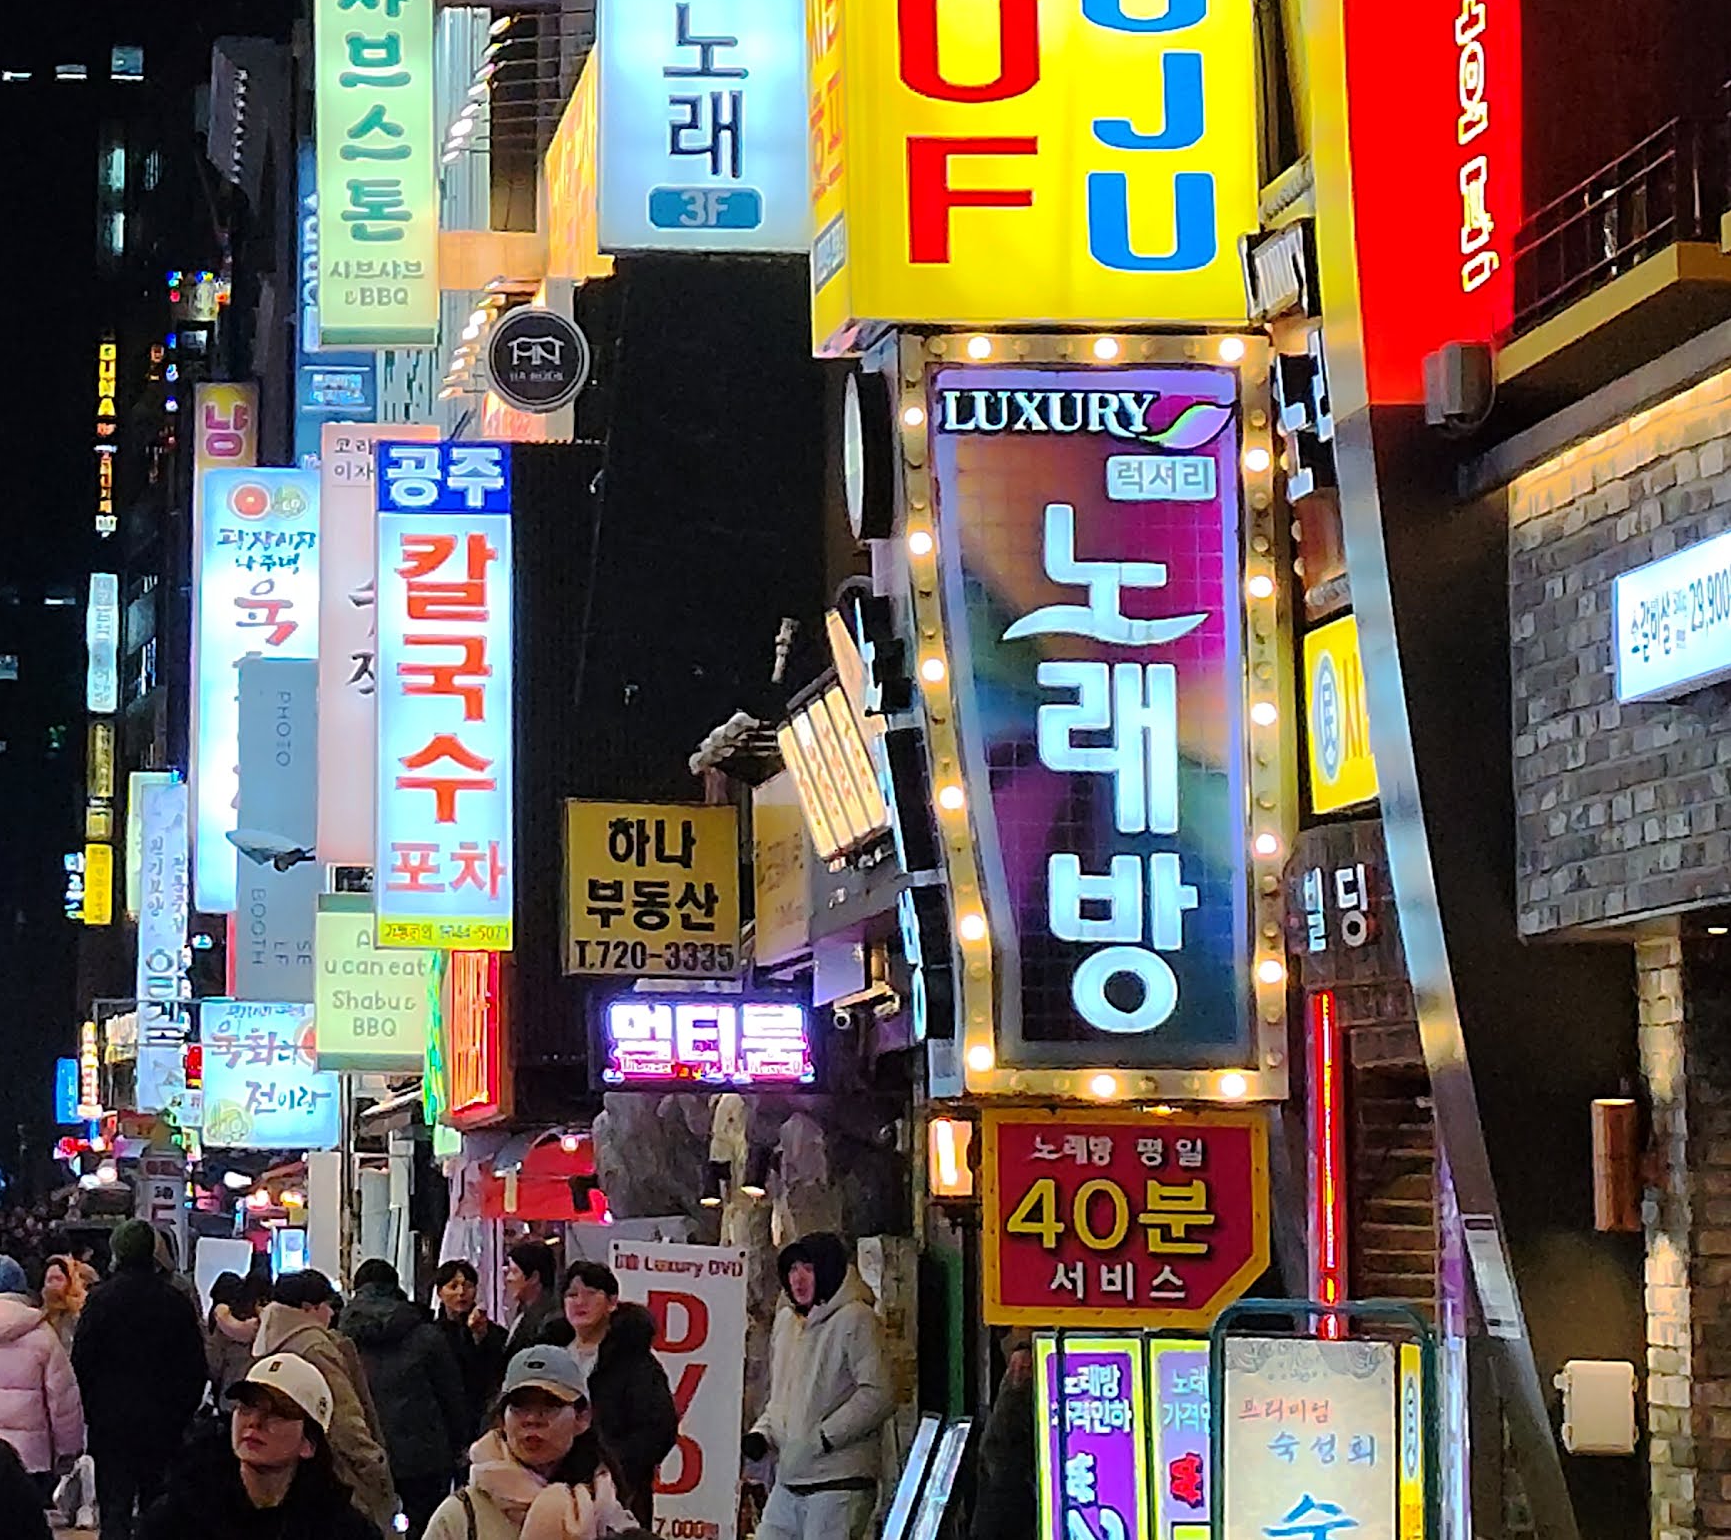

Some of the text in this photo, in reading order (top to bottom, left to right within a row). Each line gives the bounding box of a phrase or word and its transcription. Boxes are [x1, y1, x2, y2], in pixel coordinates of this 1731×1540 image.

[678, 193, 730, 227] 3F
[942, 391, 1154, 441] LUXURY
[385, 445, 505, 509] 공주
[1114, 461, 1210, 494] 럭셔리
[391, 530, 503, 825] 칼국수
[1002, 503, 1210, 1035] 노래방
[606, 816, 698, 871] 하나
[385, 836, 508, 903] 포차
[584, 877, 720, 934] 부동산
[574, 938, 735, 974] T.720-3335
[332, 990, 401, 1011] Shabu
[352, 1017, 398, 1038] BBQ
[1031, 1134, 1205, 1167] 노래방 평일
[1006, 1178, 1216, 1254] 40분
[1049, 1261, 1188, 1301] 서비스
[1268, 1431, 1378, 1467] 숙성회
